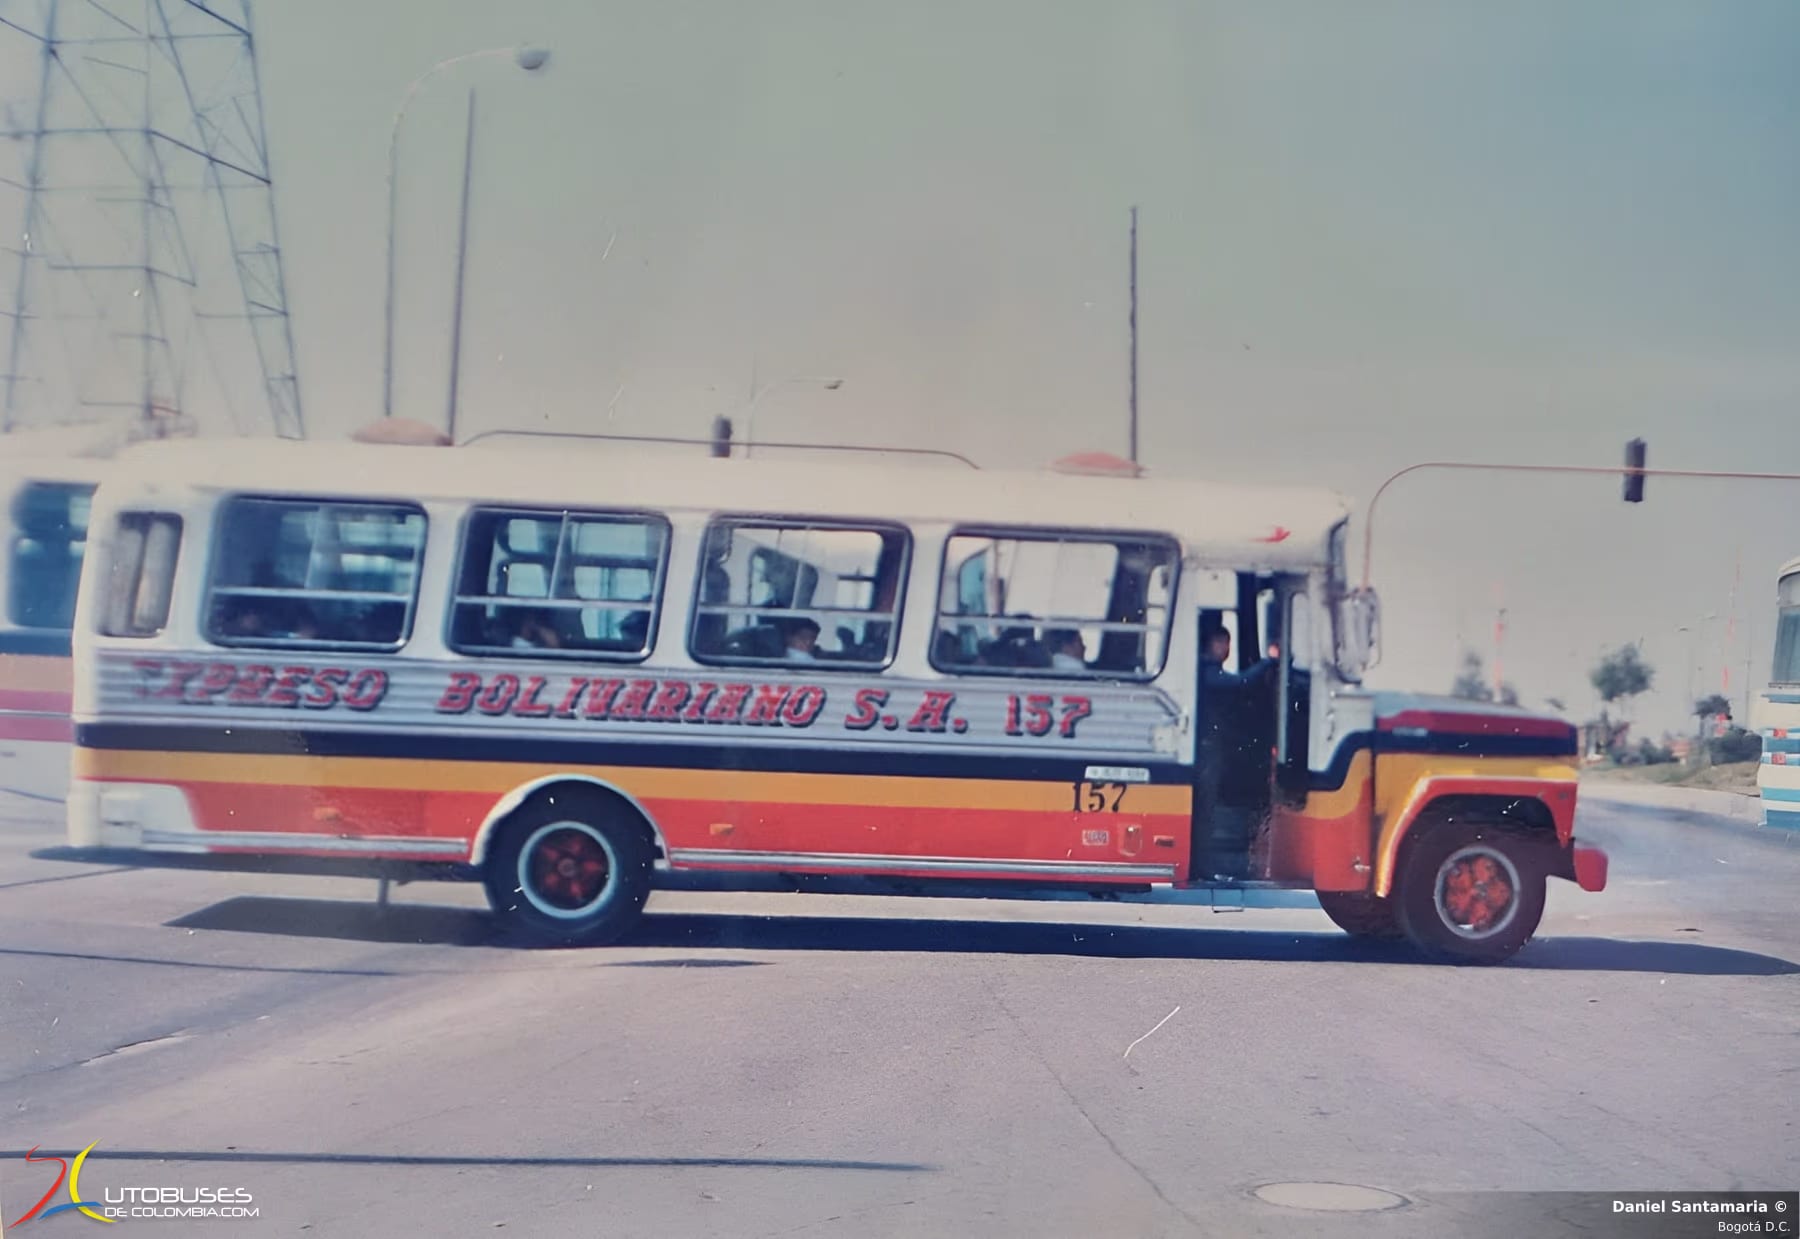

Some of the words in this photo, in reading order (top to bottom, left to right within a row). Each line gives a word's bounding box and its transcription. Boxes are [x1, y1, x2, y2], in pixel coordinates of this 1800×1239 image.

[435, 672, 827, 727] BOLIVARIANO
[1004, 693, 1091, 738] 157
[1072, 781, 1127, 813] 157
